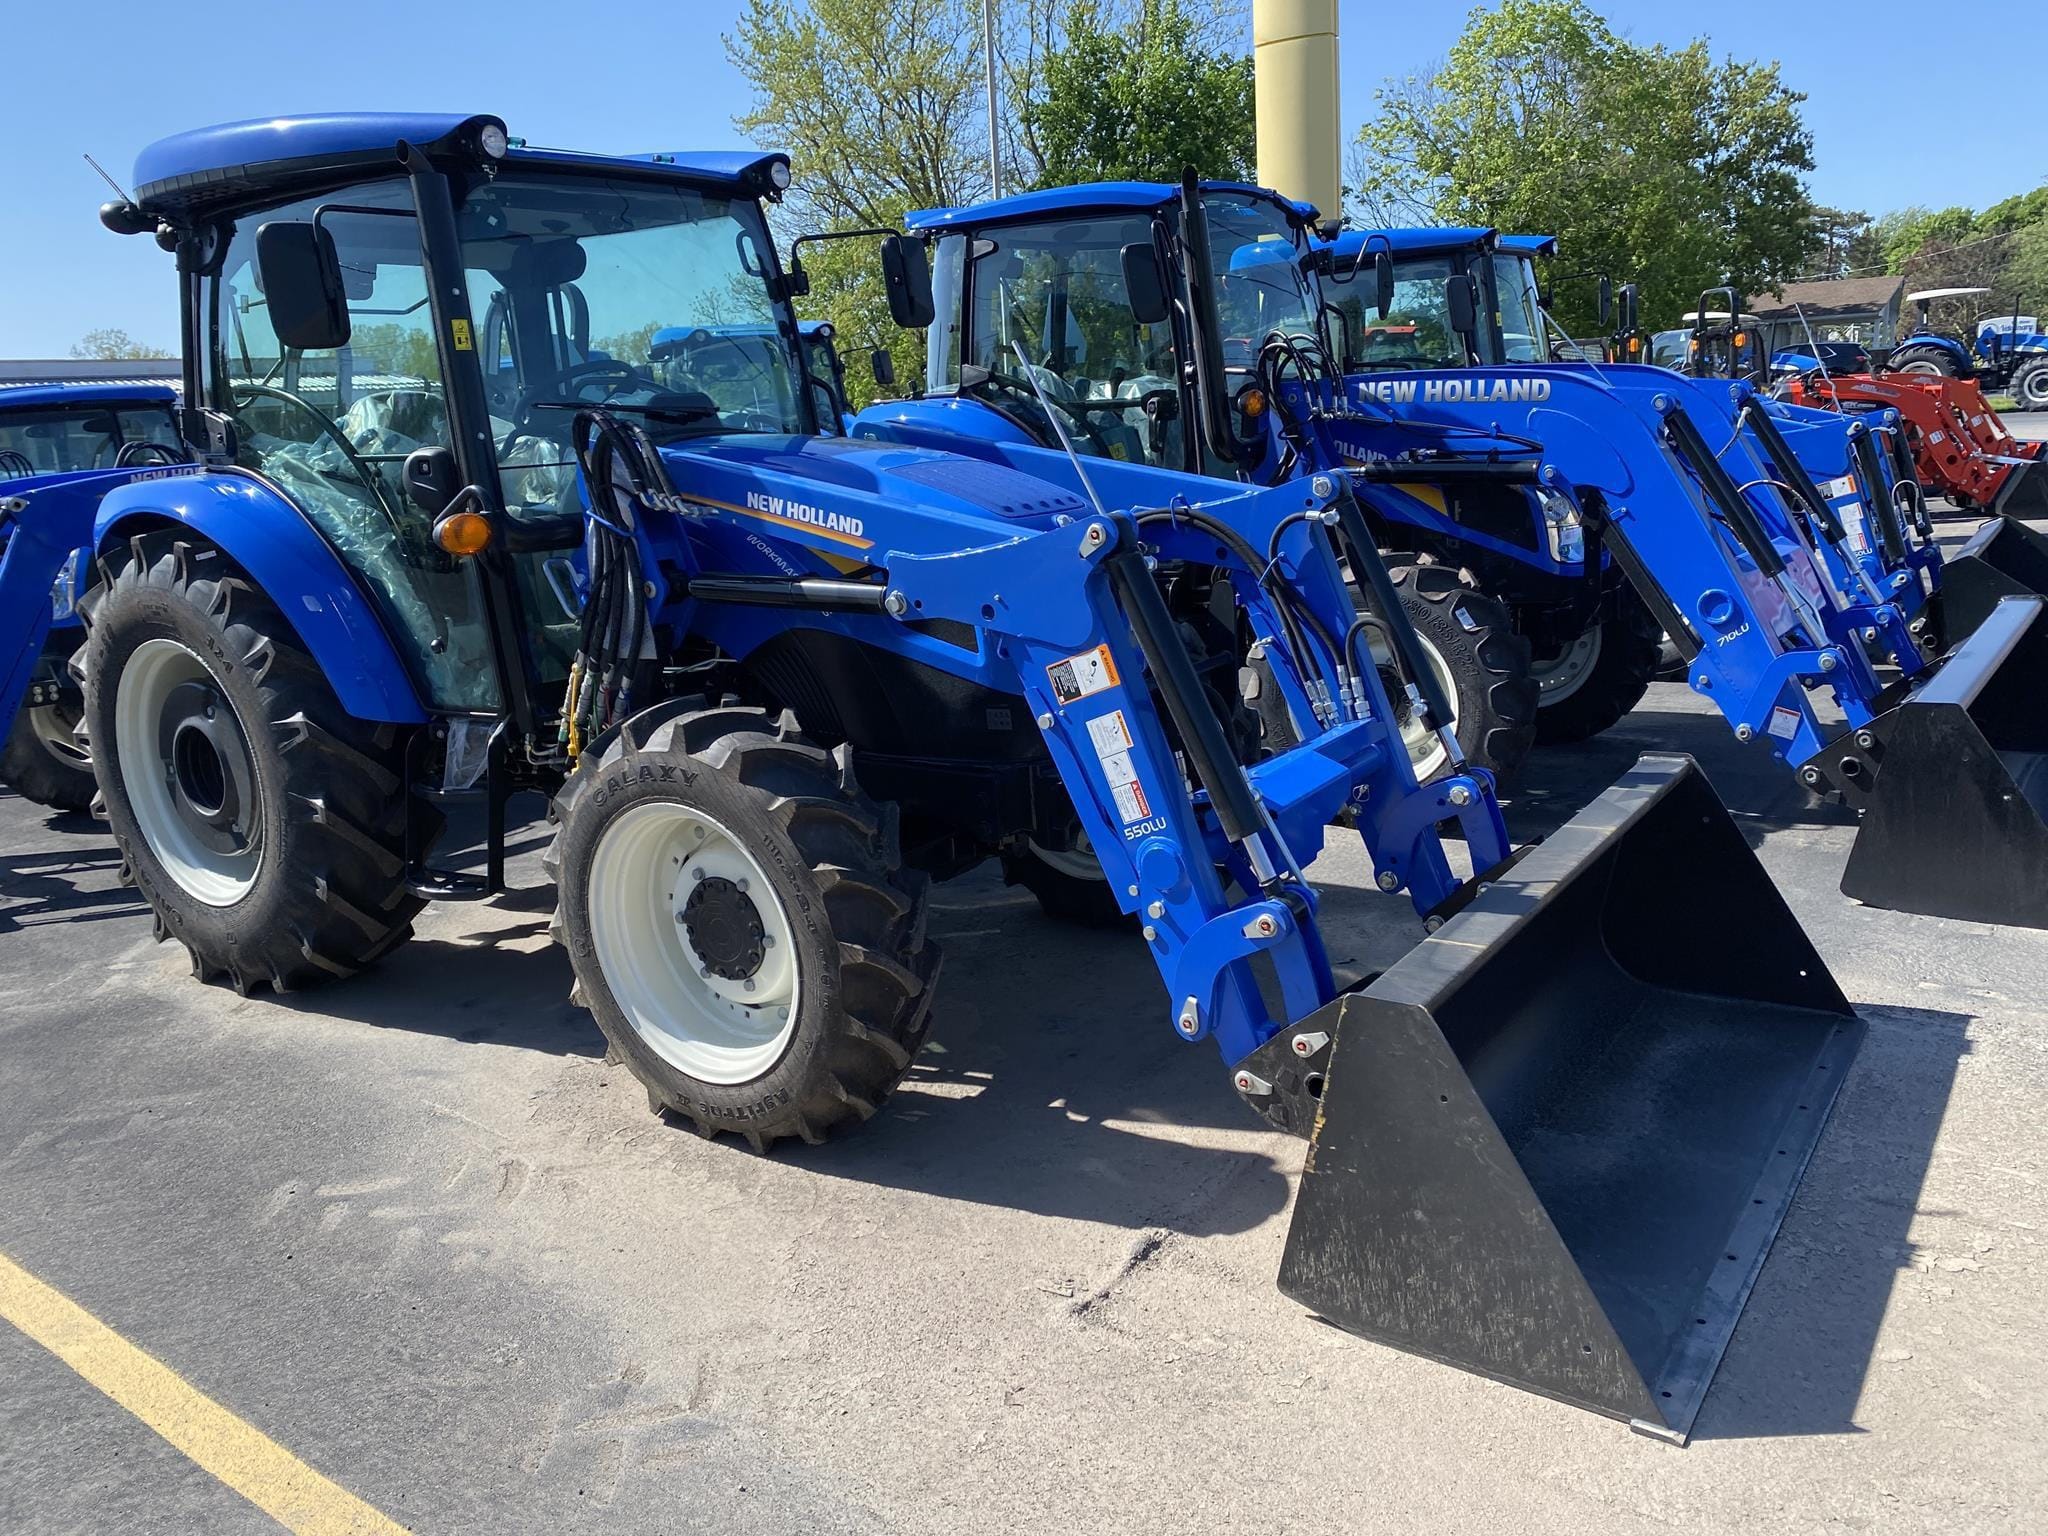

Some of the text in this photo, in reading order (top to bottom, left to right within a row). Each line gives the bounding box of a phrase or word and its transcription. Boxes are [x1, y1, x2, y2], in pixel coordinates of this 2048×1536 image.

[1358, 378, 1551, 403] NEW HOLLAND
[747, 491, 864, 537] NEW HOLLAND
[1717, 622, 1750, 648] 710LU
[593, 763, 699, 807] GALAXY
[1124, 816, 1167, 841] 550LU
